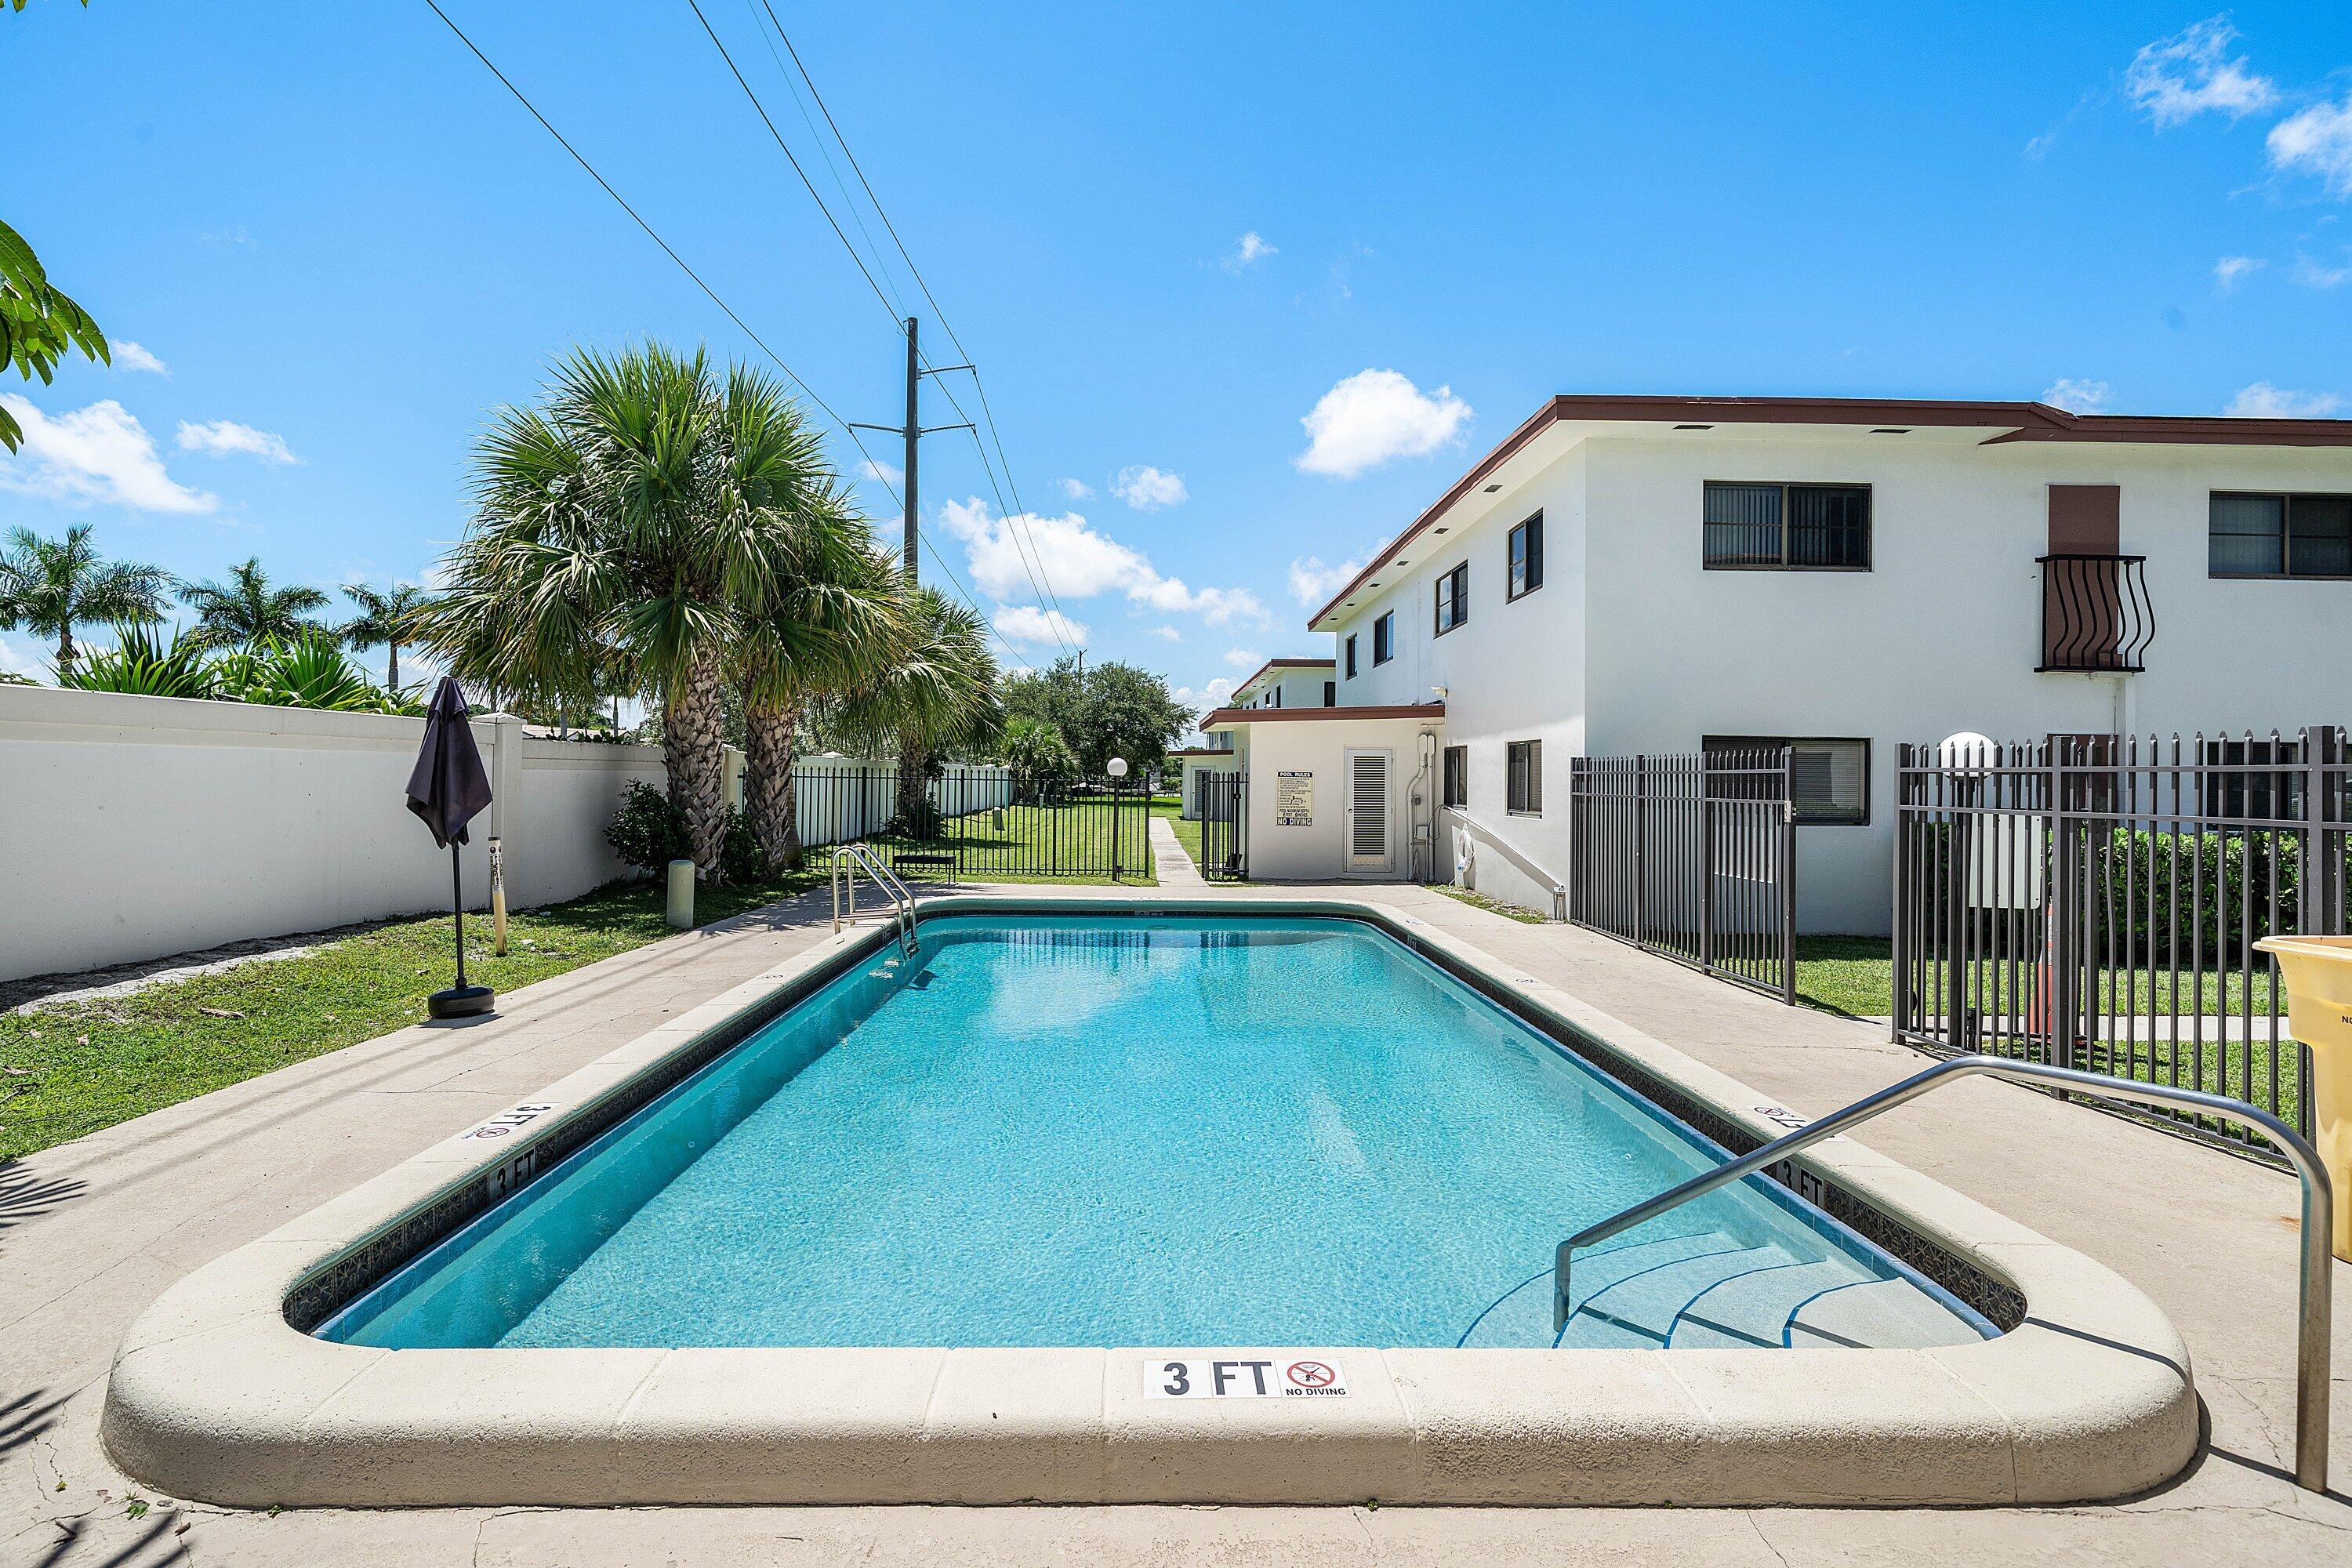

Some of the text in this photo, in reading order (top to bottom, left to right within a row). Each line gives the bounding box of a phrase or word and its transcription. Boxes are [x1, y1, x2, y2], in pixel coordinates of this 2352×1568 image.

[490, 1114, 539, 1126] FT
[514, 1148, 535, 1189] FT
[1783, 1160, 1823, 1206] 3 FT
[1163, 1361, 1272, 1396] 3 FT
